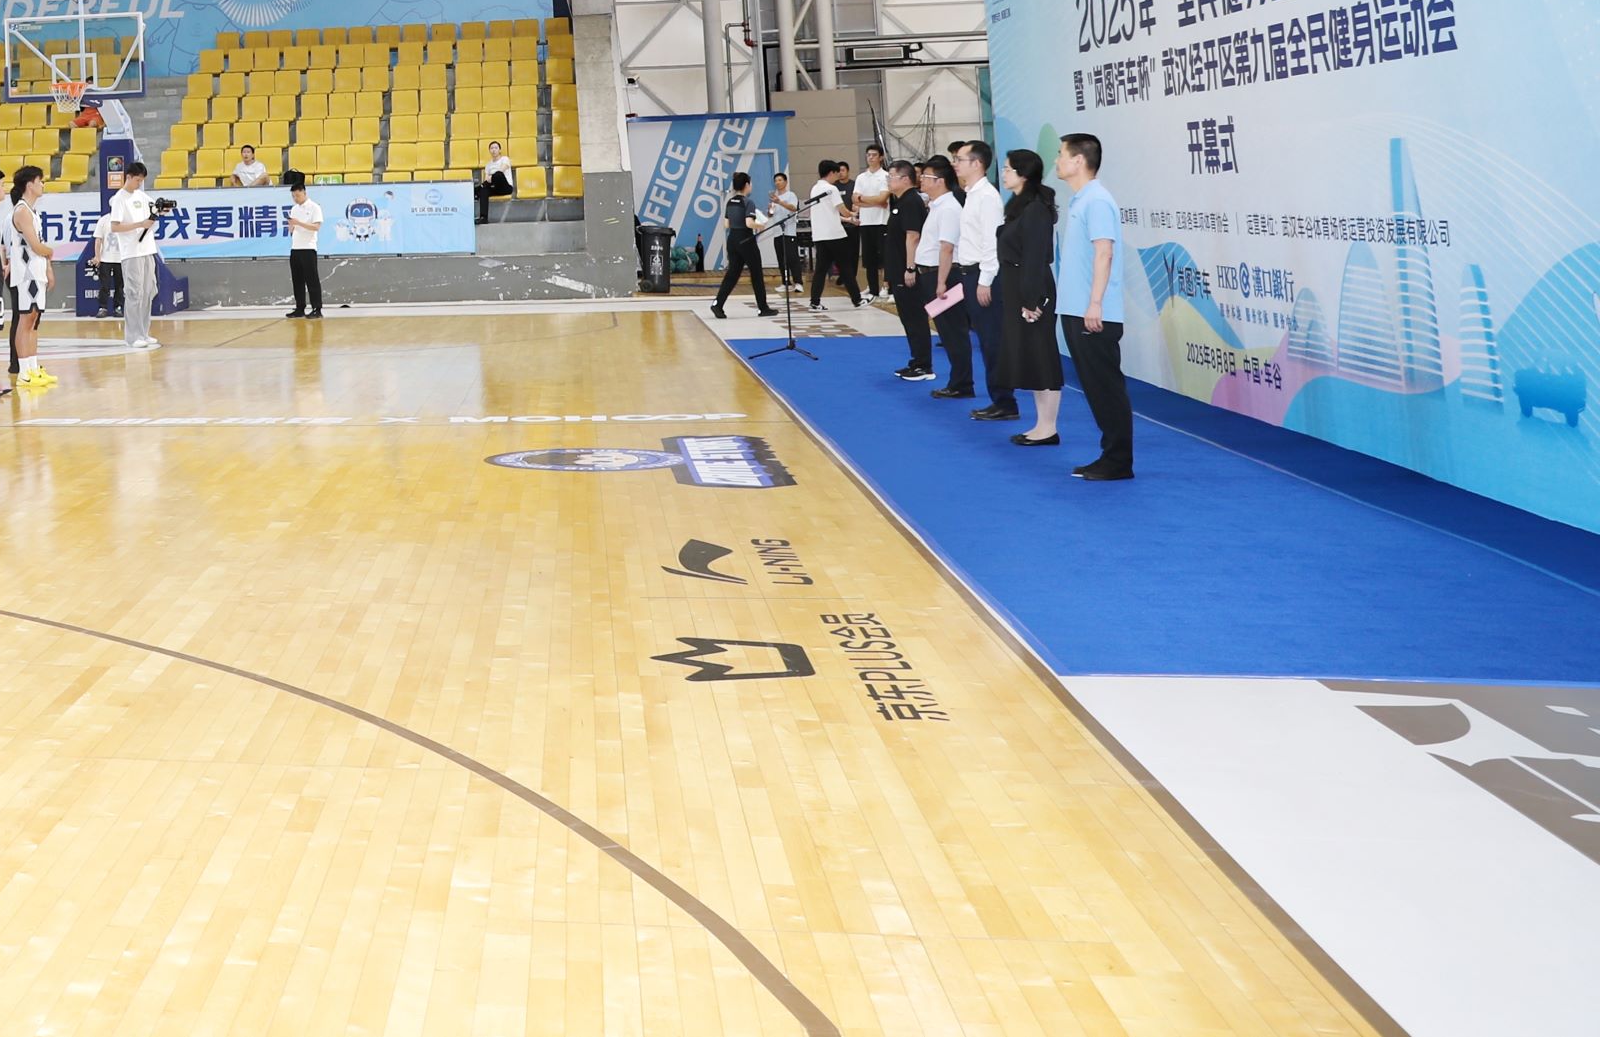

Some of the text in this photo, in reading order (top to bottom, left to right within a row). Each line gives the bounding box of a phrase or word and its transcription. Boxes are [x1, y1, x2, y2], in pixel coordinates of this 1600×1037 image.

[693, 118, 750, 219] OFFICE
[1186, 115, 1240, 175] 开幕式
[1216, 265, 1239, 291] HKB
[1252, 266, 1295, 304] 漢口銀行
[1186, 342, 1237, 377] 2025年8月8日
[750, 538, 814, 586] LI-NING
[819, 612, 951, 722] 京东PLUS会员
